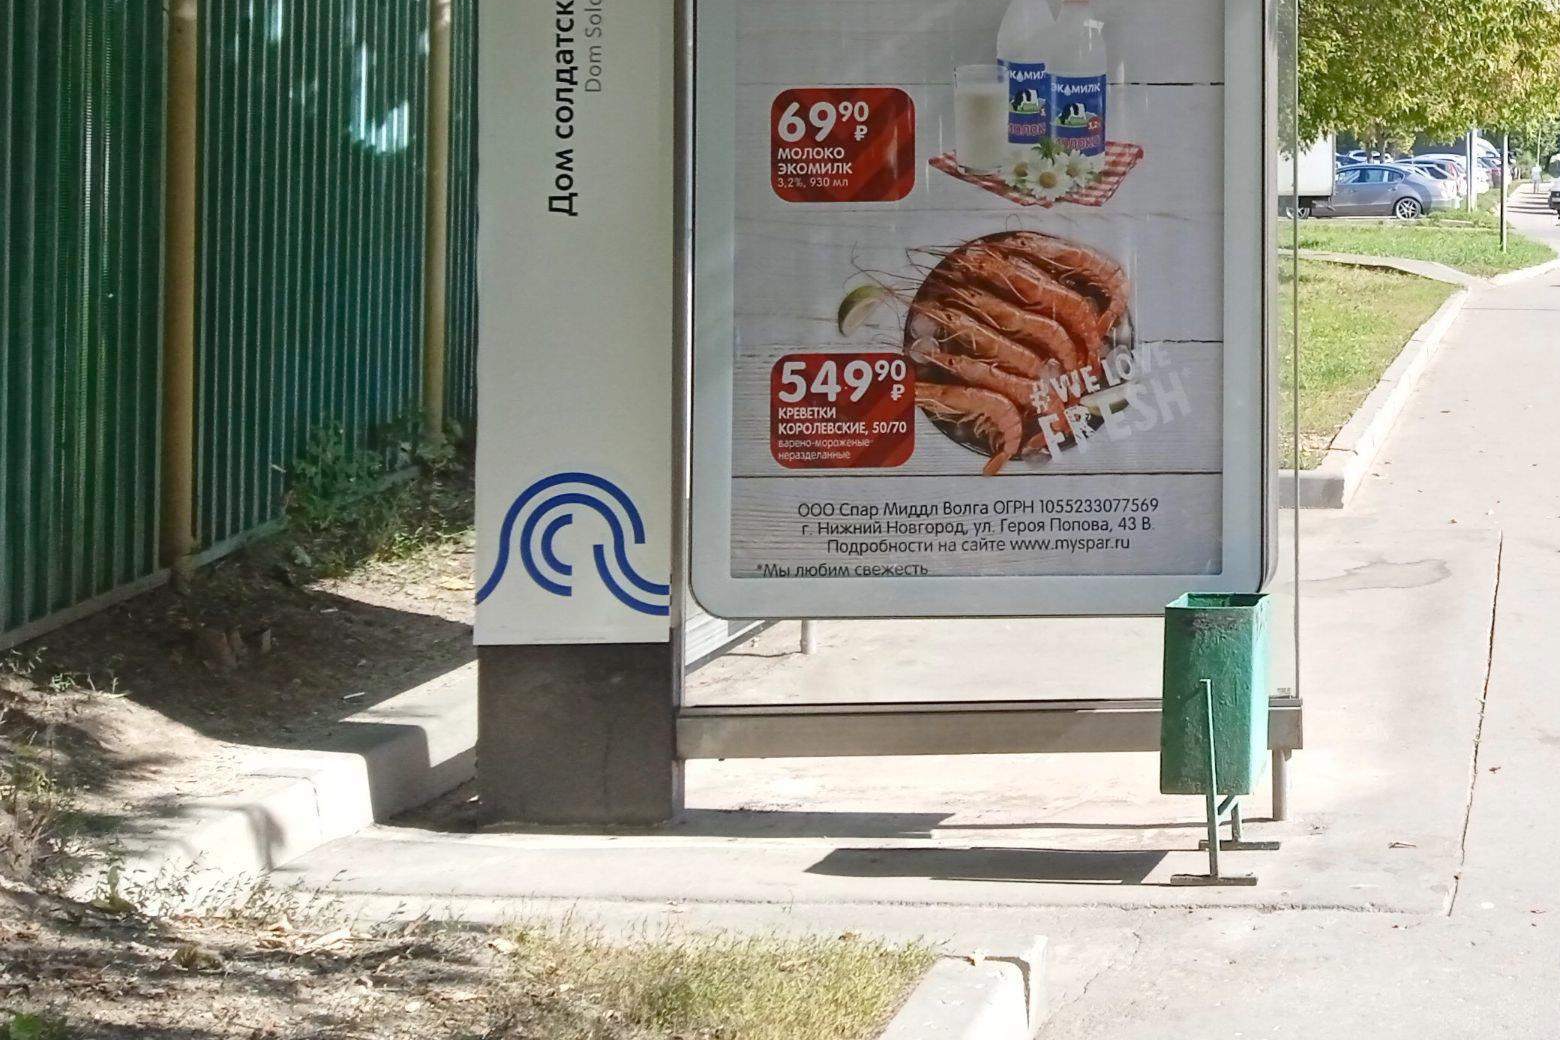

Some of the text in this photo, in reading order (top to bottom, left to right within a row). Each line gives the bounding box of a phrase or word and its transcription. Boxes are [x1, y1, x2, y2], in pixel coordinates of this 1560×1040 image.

[585, 47, 602, 92] Dom
[778, 101, 837, 143] 69
[778, 147, 845, 160] МОЛОКО
[778, 163, 853, 175] ЭКОМИЛК
[549, 149, 578, 216] Дом
[809, 177, 830, 188] 930
[832, 179, 849, 187] мл
[778, 360, 873, 403] 549
[778, 407, 837, 419] КРЕВЕТКИ
[778, 421, 907, 435] КОРОЛЕВСКИЕ, 50/70
[778, 451, 851, 462] неразделанные
[798, 498, 1159, 519] ООО Спар Миддл Волга ОГРН 1055233077569
[802, 524, 813, 536] г.
[818, 521, 882, 535] Нижний
[887, 520, 968, 537] Новгород,
[973, 522, 995, 536] ул.
[1000, 519, 1045, 535] Героя
[1050, 518, 1113, 533] Попова,
[1117, 517, 1137, 531] 43
[827, 537, 1130, 556] Подробности на сайте www.myspar.ru
[795, 564, 850, 577] любим
[854, 564, 929, 577] свежесть
